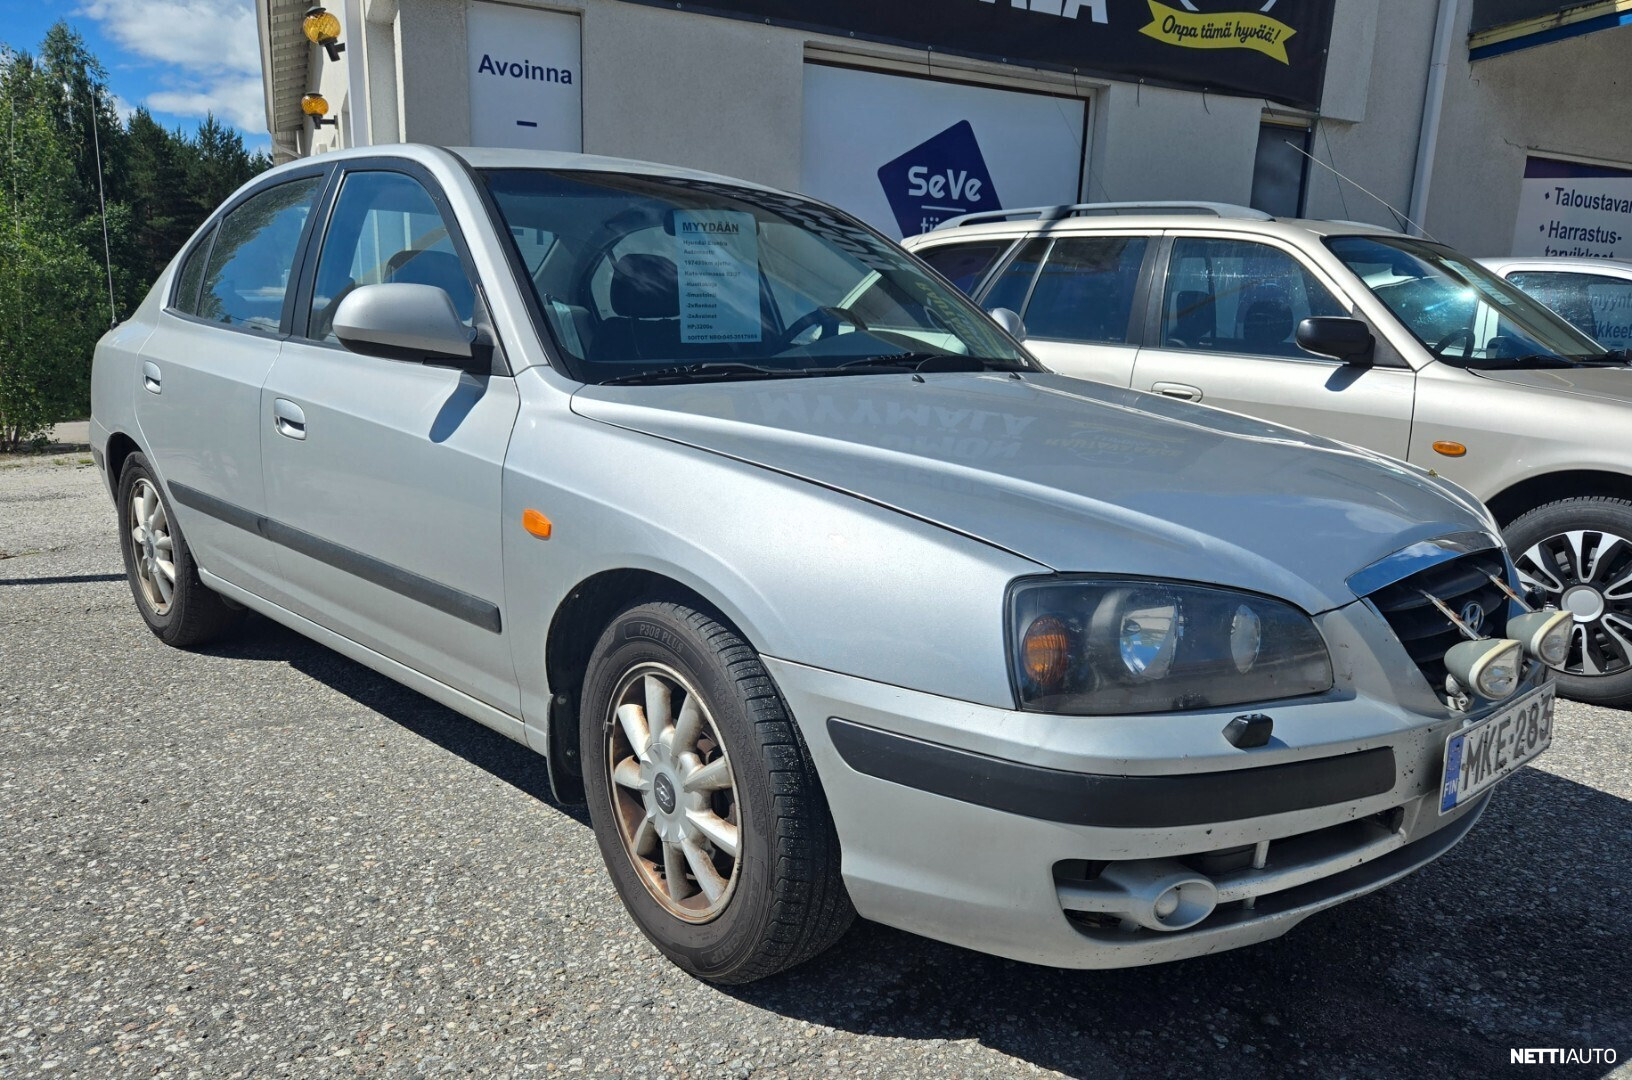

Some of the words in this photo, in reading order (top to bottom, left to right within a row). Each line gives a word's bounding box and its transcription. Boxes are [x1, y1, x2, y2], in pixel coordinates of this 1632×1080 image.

[1162, 14, 1199, 42] Onpa
[1200, 20, 1232, 39] tämä
[1233, 20, 1282, 45] hyvää!
[478, 54, 573, 85] Avoinna
[907, 165, 983, 202] SeVe
[682, 221, 739, 234] MYYDÄÄN
[1547, 219, 1622, 245] Harrastus-
[661, 632, 684, 653] PLUS
[1462, 693, 1553, 791] MKE-283
[1443, 778, 1459, 797] FIN
